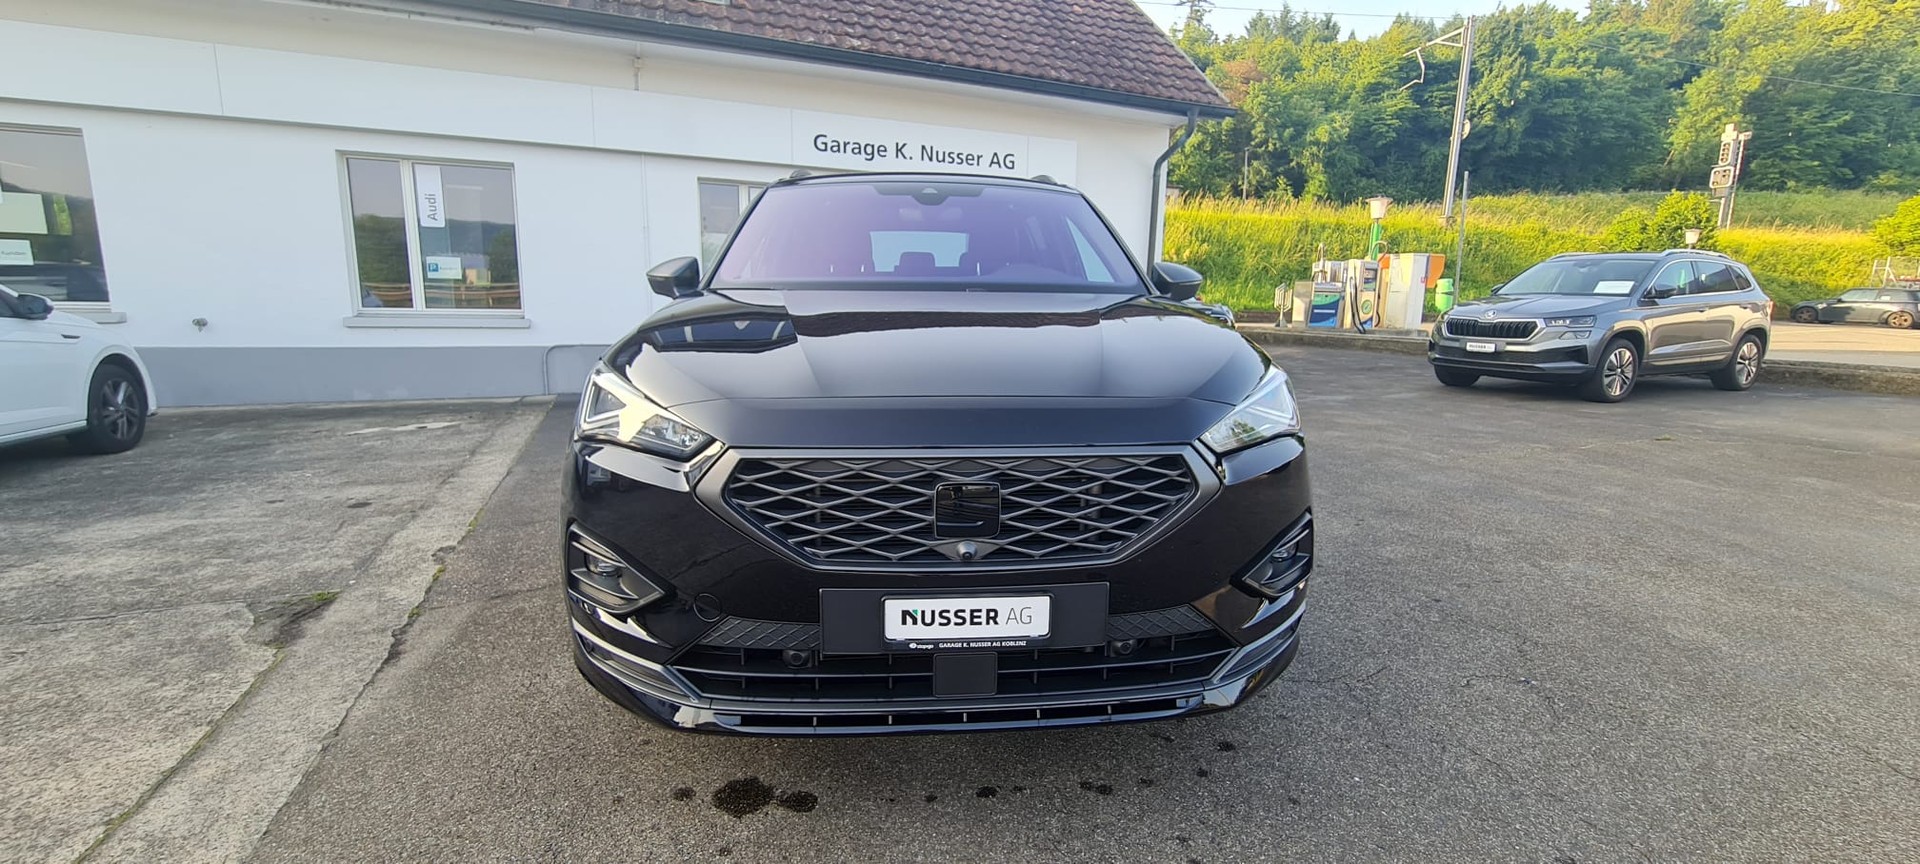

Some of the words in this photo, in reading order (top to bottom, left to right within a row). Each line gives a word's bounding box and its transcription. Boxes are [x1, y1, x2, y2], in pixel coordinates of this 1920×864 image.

[814, 134, 888, 161] Garage
[895, 142, 913, 160] K.
[921, 145, 983, 167] Nusser
[989, 152, 1015, 169] AG
[424, 193, 438, 221] Audi
[901, 608, 999, 627] NUSSER
[1005, 607, 1033, 625] AG
